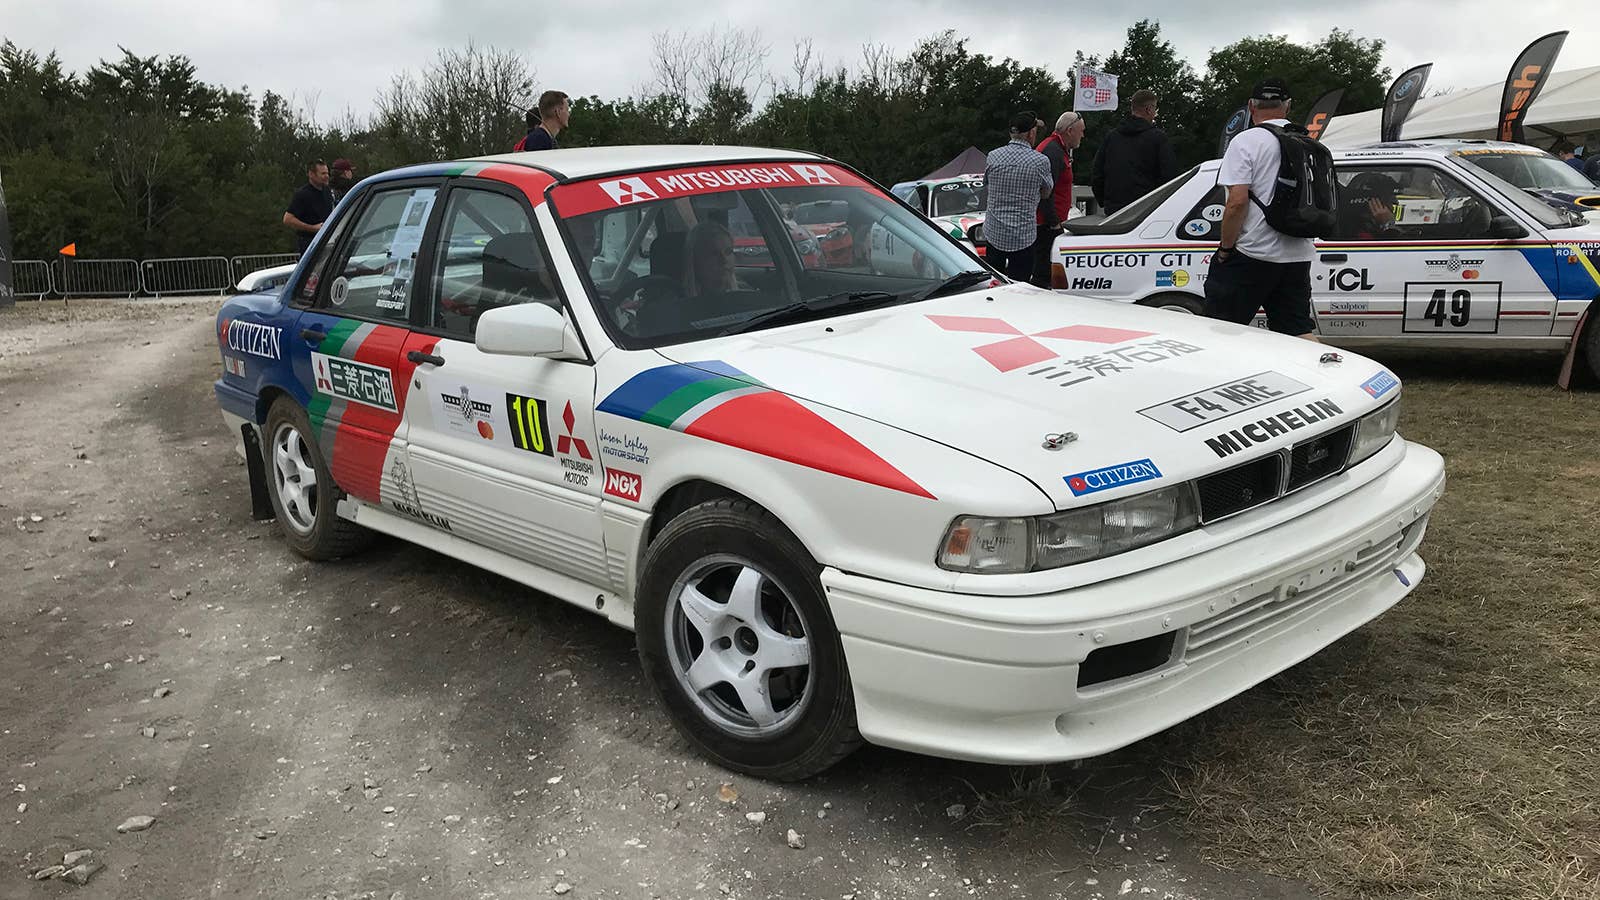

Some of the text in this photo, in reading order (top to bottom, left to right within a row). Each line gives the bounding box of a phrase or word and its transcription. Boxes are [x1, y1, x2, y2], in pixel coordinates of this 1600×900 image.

[656, 166, 795, 193] MITSUBISHI
[1209, 208, 1222, 217] 49
[1065, 254, 1150, 268] PEUGEOT
[1161, 253, 1191, 267] GTI
[1072, 277, 1112, 290] Hella
[1331, 302, 1368, 312] Sculptor
[1424, 289, 1471, 327] 49
[228, 319, 283, 360] CITIZEN
[1028, 340, 1205, 387] 三菱石油
[331, 363, 394, 405] 三菱石油
[1371, 372, 1398, 393] CITIZEN
[1172, 379, 1284, 420] F4 MRE
[513, 396, 545, 453] 10
[1204, 398, 1344, 458] MICHELIN
[600, 429, 649, 456] Jason Lepley
[603, 446, 650, 464] MOTORSPORT
[560, 457, 594, 475] MITSUBISHI
[564, 471, 589, 486] MOTORS
[1084, 461, 1157, 490] CITIZEN
[608, 473, 639, 497] NGK
[392, 501, 453, 531] MICHELIN
